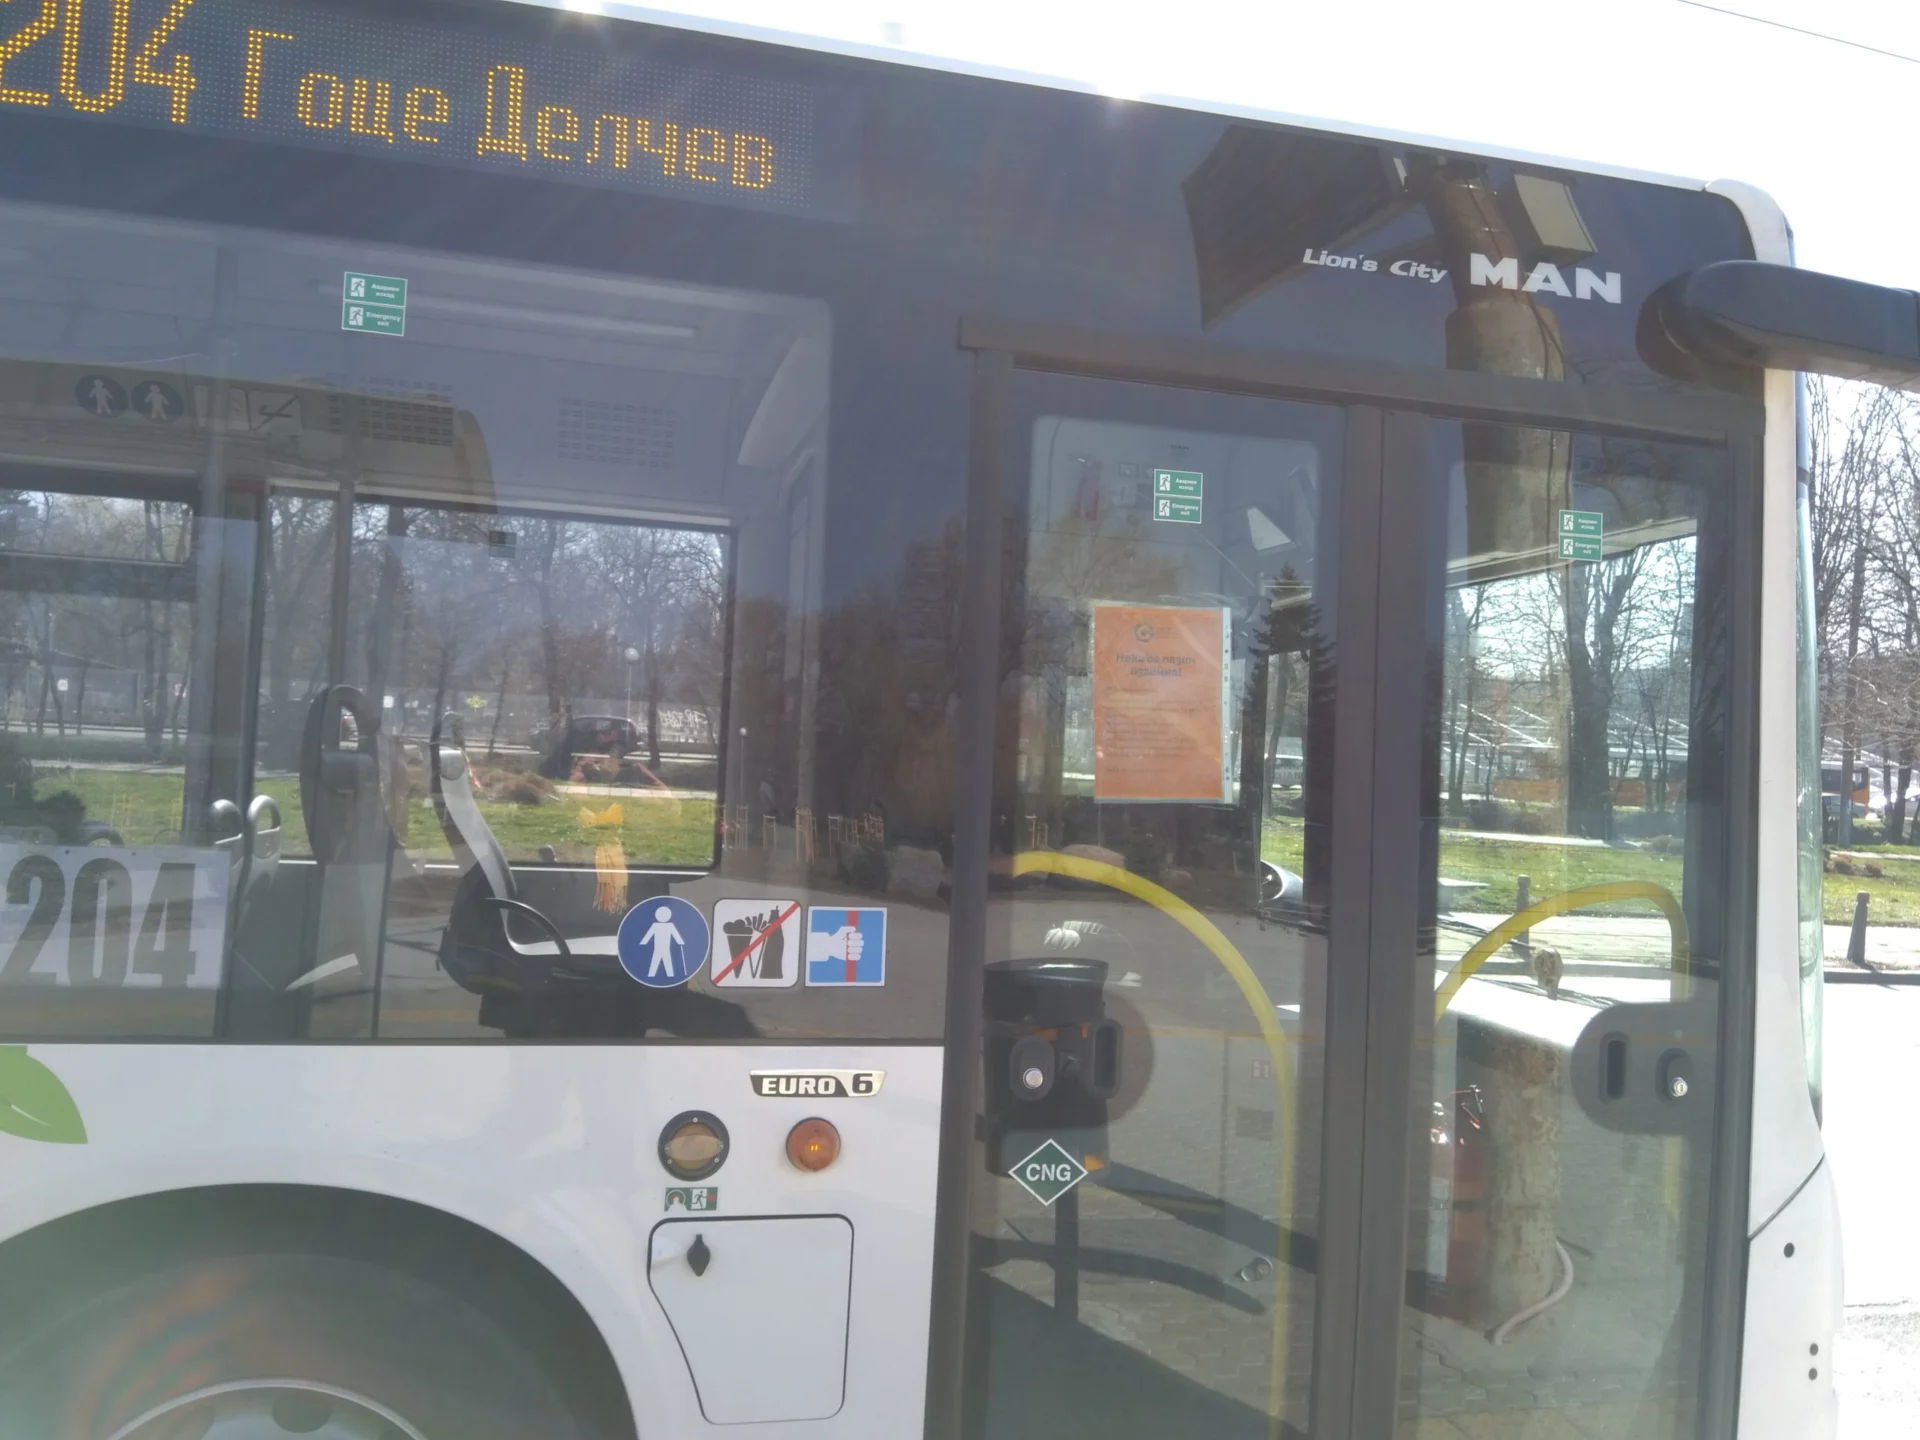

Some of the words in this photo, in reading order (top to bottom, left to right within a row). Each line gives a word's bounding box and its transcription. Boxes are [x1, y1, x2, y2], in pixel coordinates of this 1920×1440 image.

[0, 0, 196, 123] 204
[243, 28, 450, 144] Гоце
[477, 64, 774, 189] Делчев
[1302, 248, 1378, 272] Lion's
[1390, 260, 1448, 284] City
[1470, 253, 1622, 304] MAN
[366, 312, 401, 322] Emergency
[1172, 503, 1199, 511] Emergency
[1, 854, 196, 989] 204
[761, 1077, 836, 1095] EURO
[852, 1073, 873, 1094] 6
[1025, 1163, 1071, 1182] CNG
